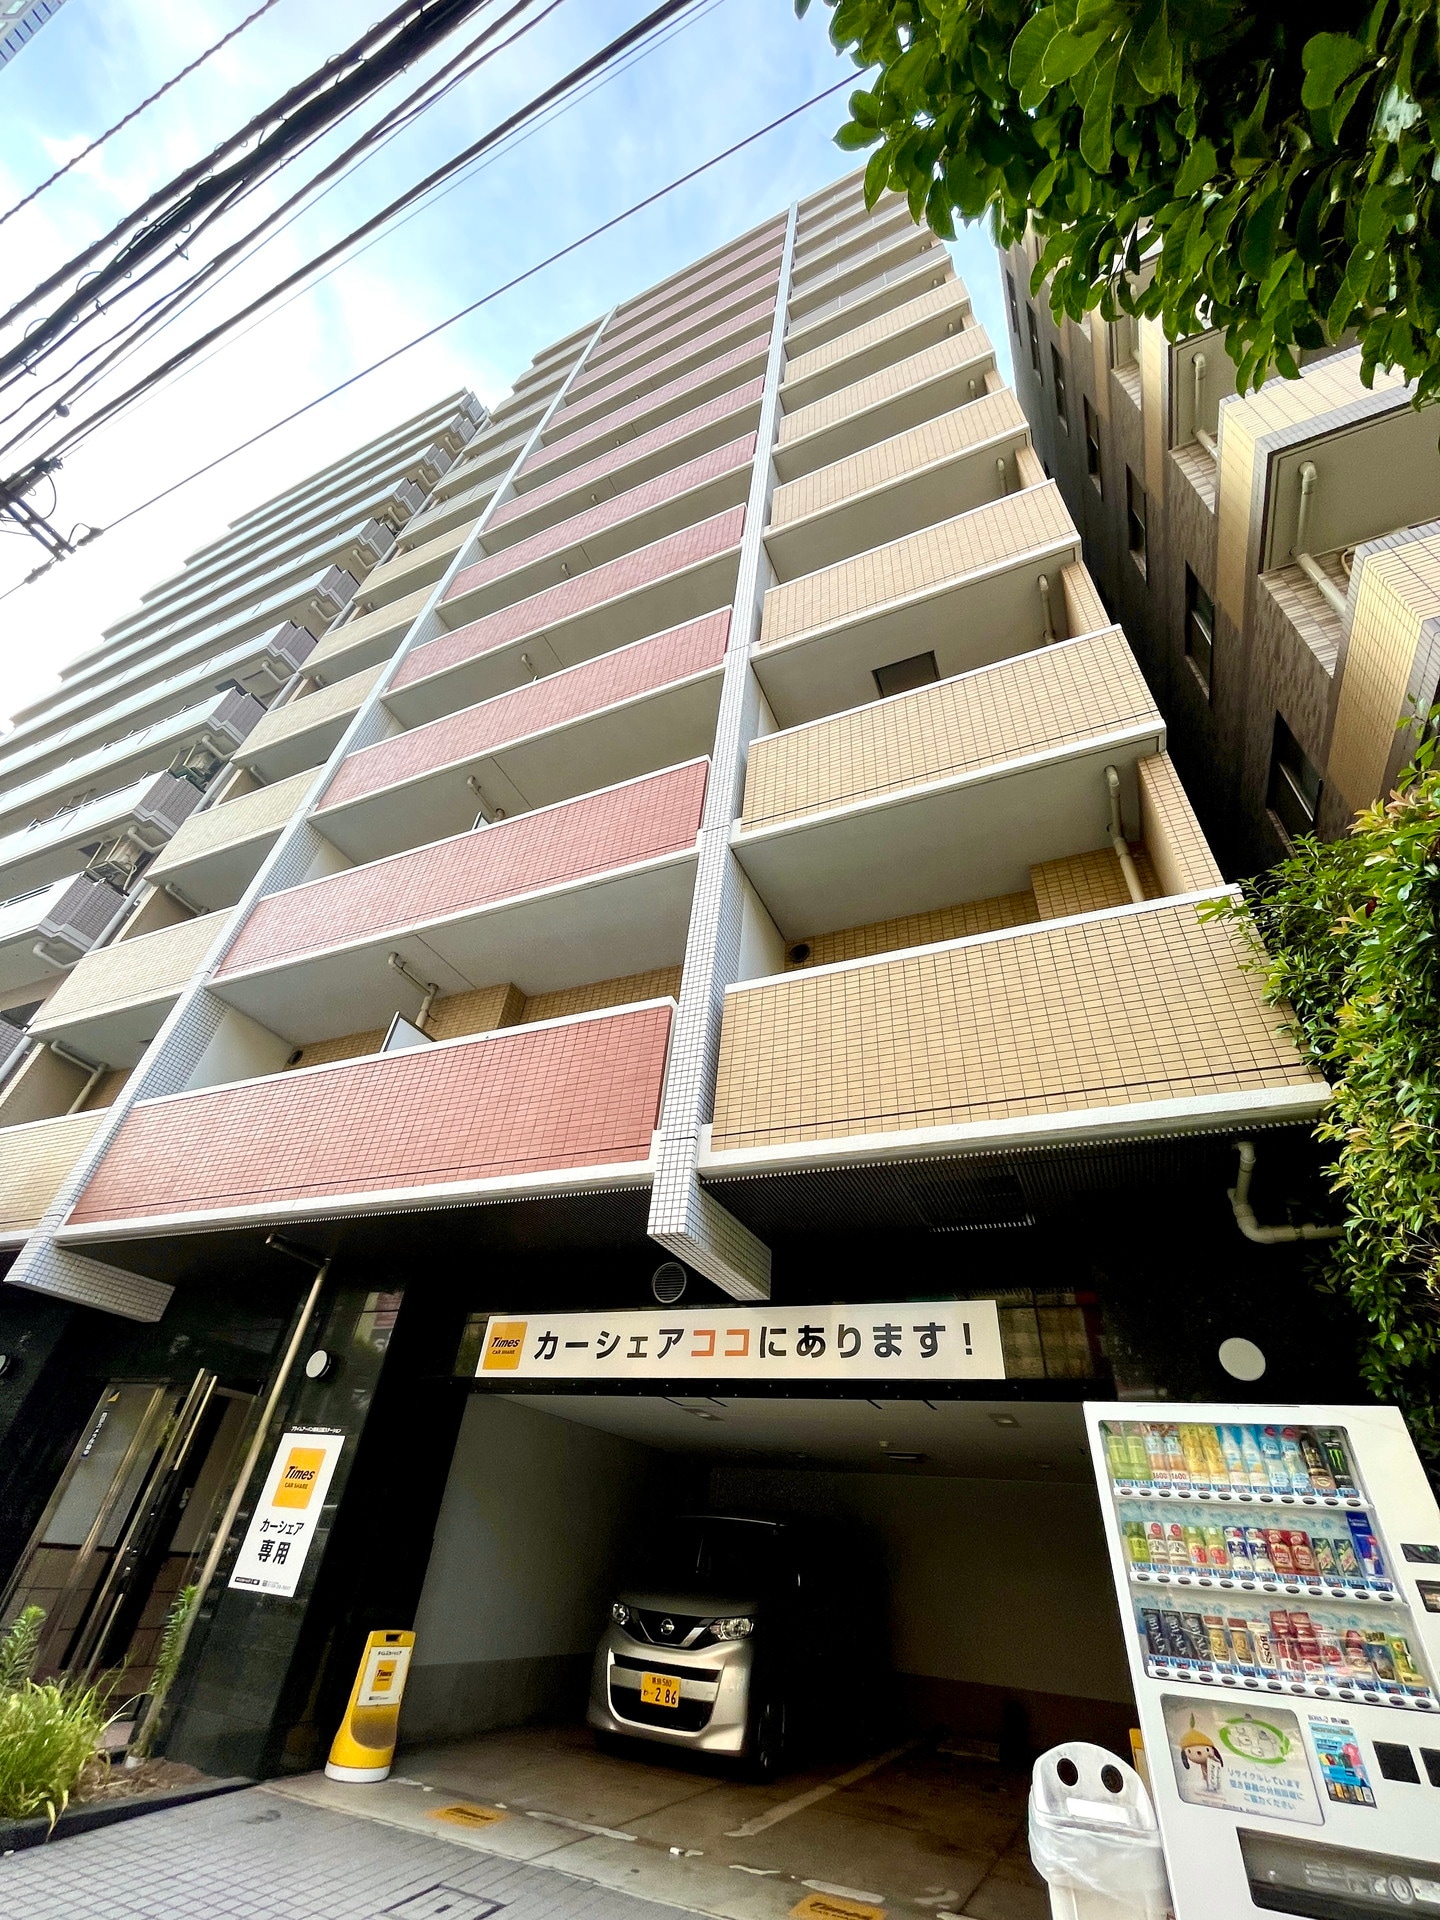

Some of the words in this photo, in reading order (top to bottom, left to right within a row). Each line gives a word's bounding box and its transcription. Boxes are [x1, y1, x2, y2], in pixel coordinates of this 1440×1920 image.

[491, 1337, 520, 1348] Times
[533, 1322, 974, 1360] カーシェアココにあります！
[284, 1465, 316, 1481] Times
[259, 1517, 305, 1536] カーシェア
[257, 1538, 292, 1565] 専用
[1259, 1634, 1274, 1665] BOSS
